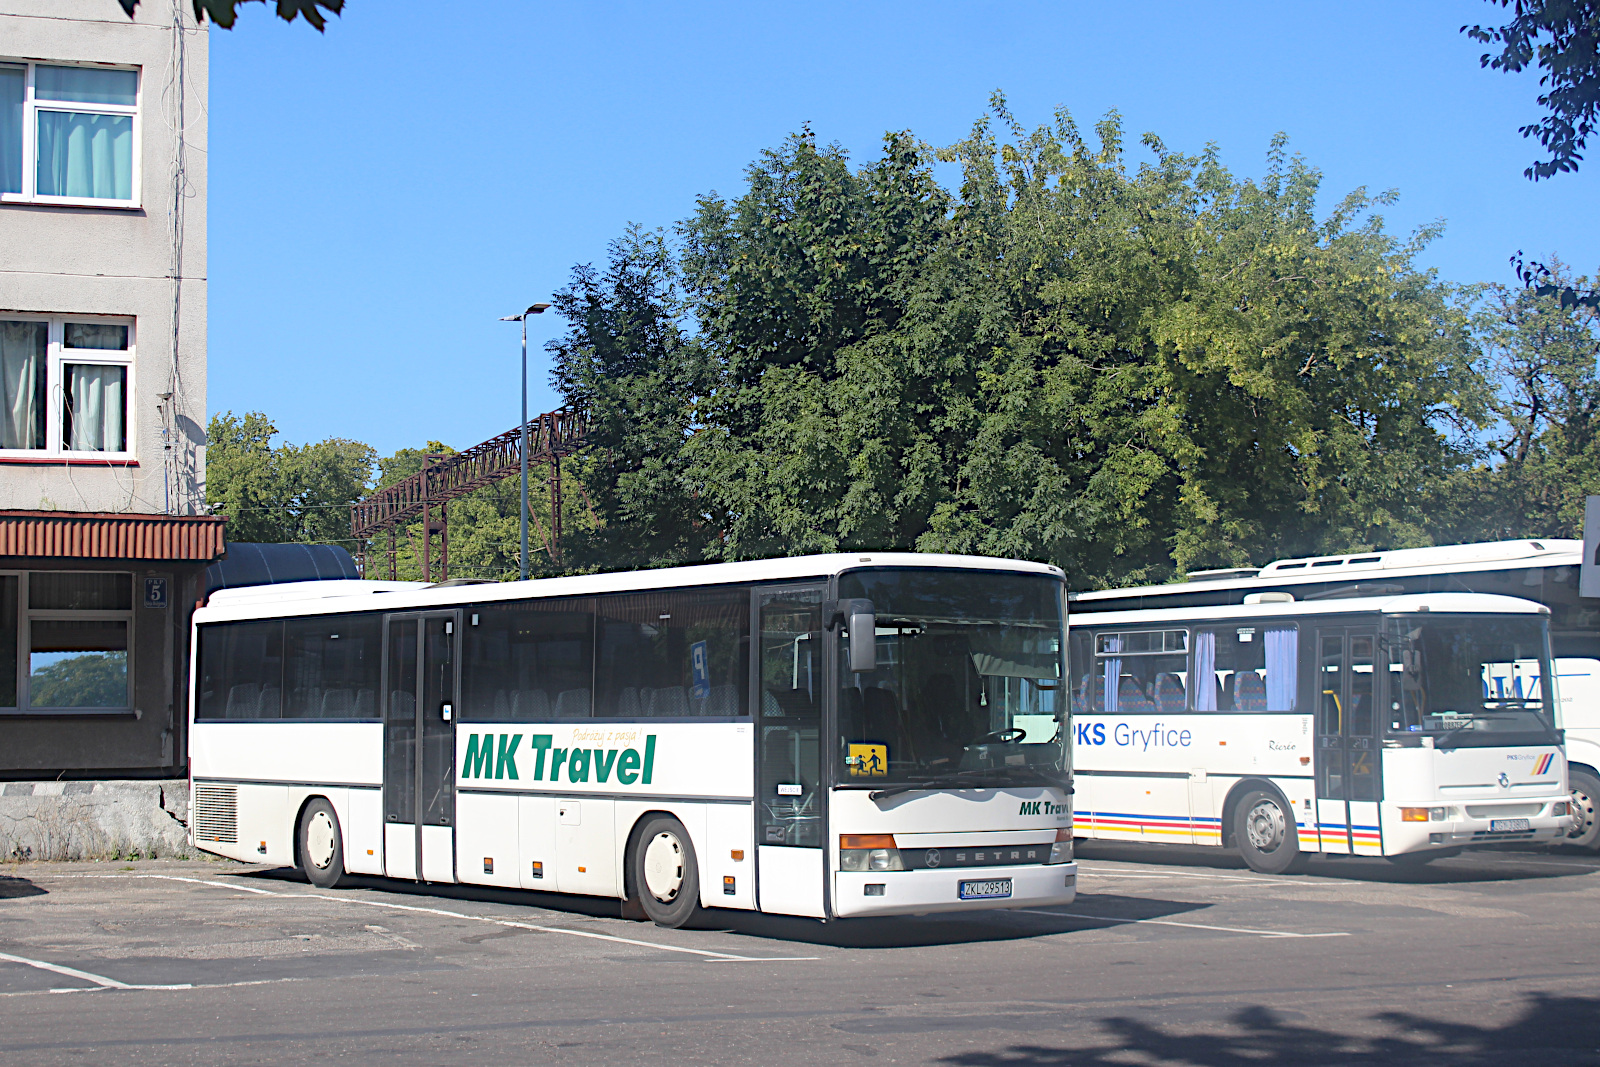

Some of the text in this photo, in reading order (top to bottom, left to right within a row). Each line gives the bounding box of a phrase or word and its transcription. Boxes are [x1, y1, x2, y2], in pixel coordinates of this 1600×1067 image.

[151, 585, 161, 601] 5
[607, 732, 613, 741] z
[1114, 722, 1192, 752] Gryfice
[461, 733, 657, 785] MK Travel
[1019, 801, 1041, 815] MK
[956, 850, 1036, 861] SETRA
[965, 881, 1010, 895] ZKL 29513
